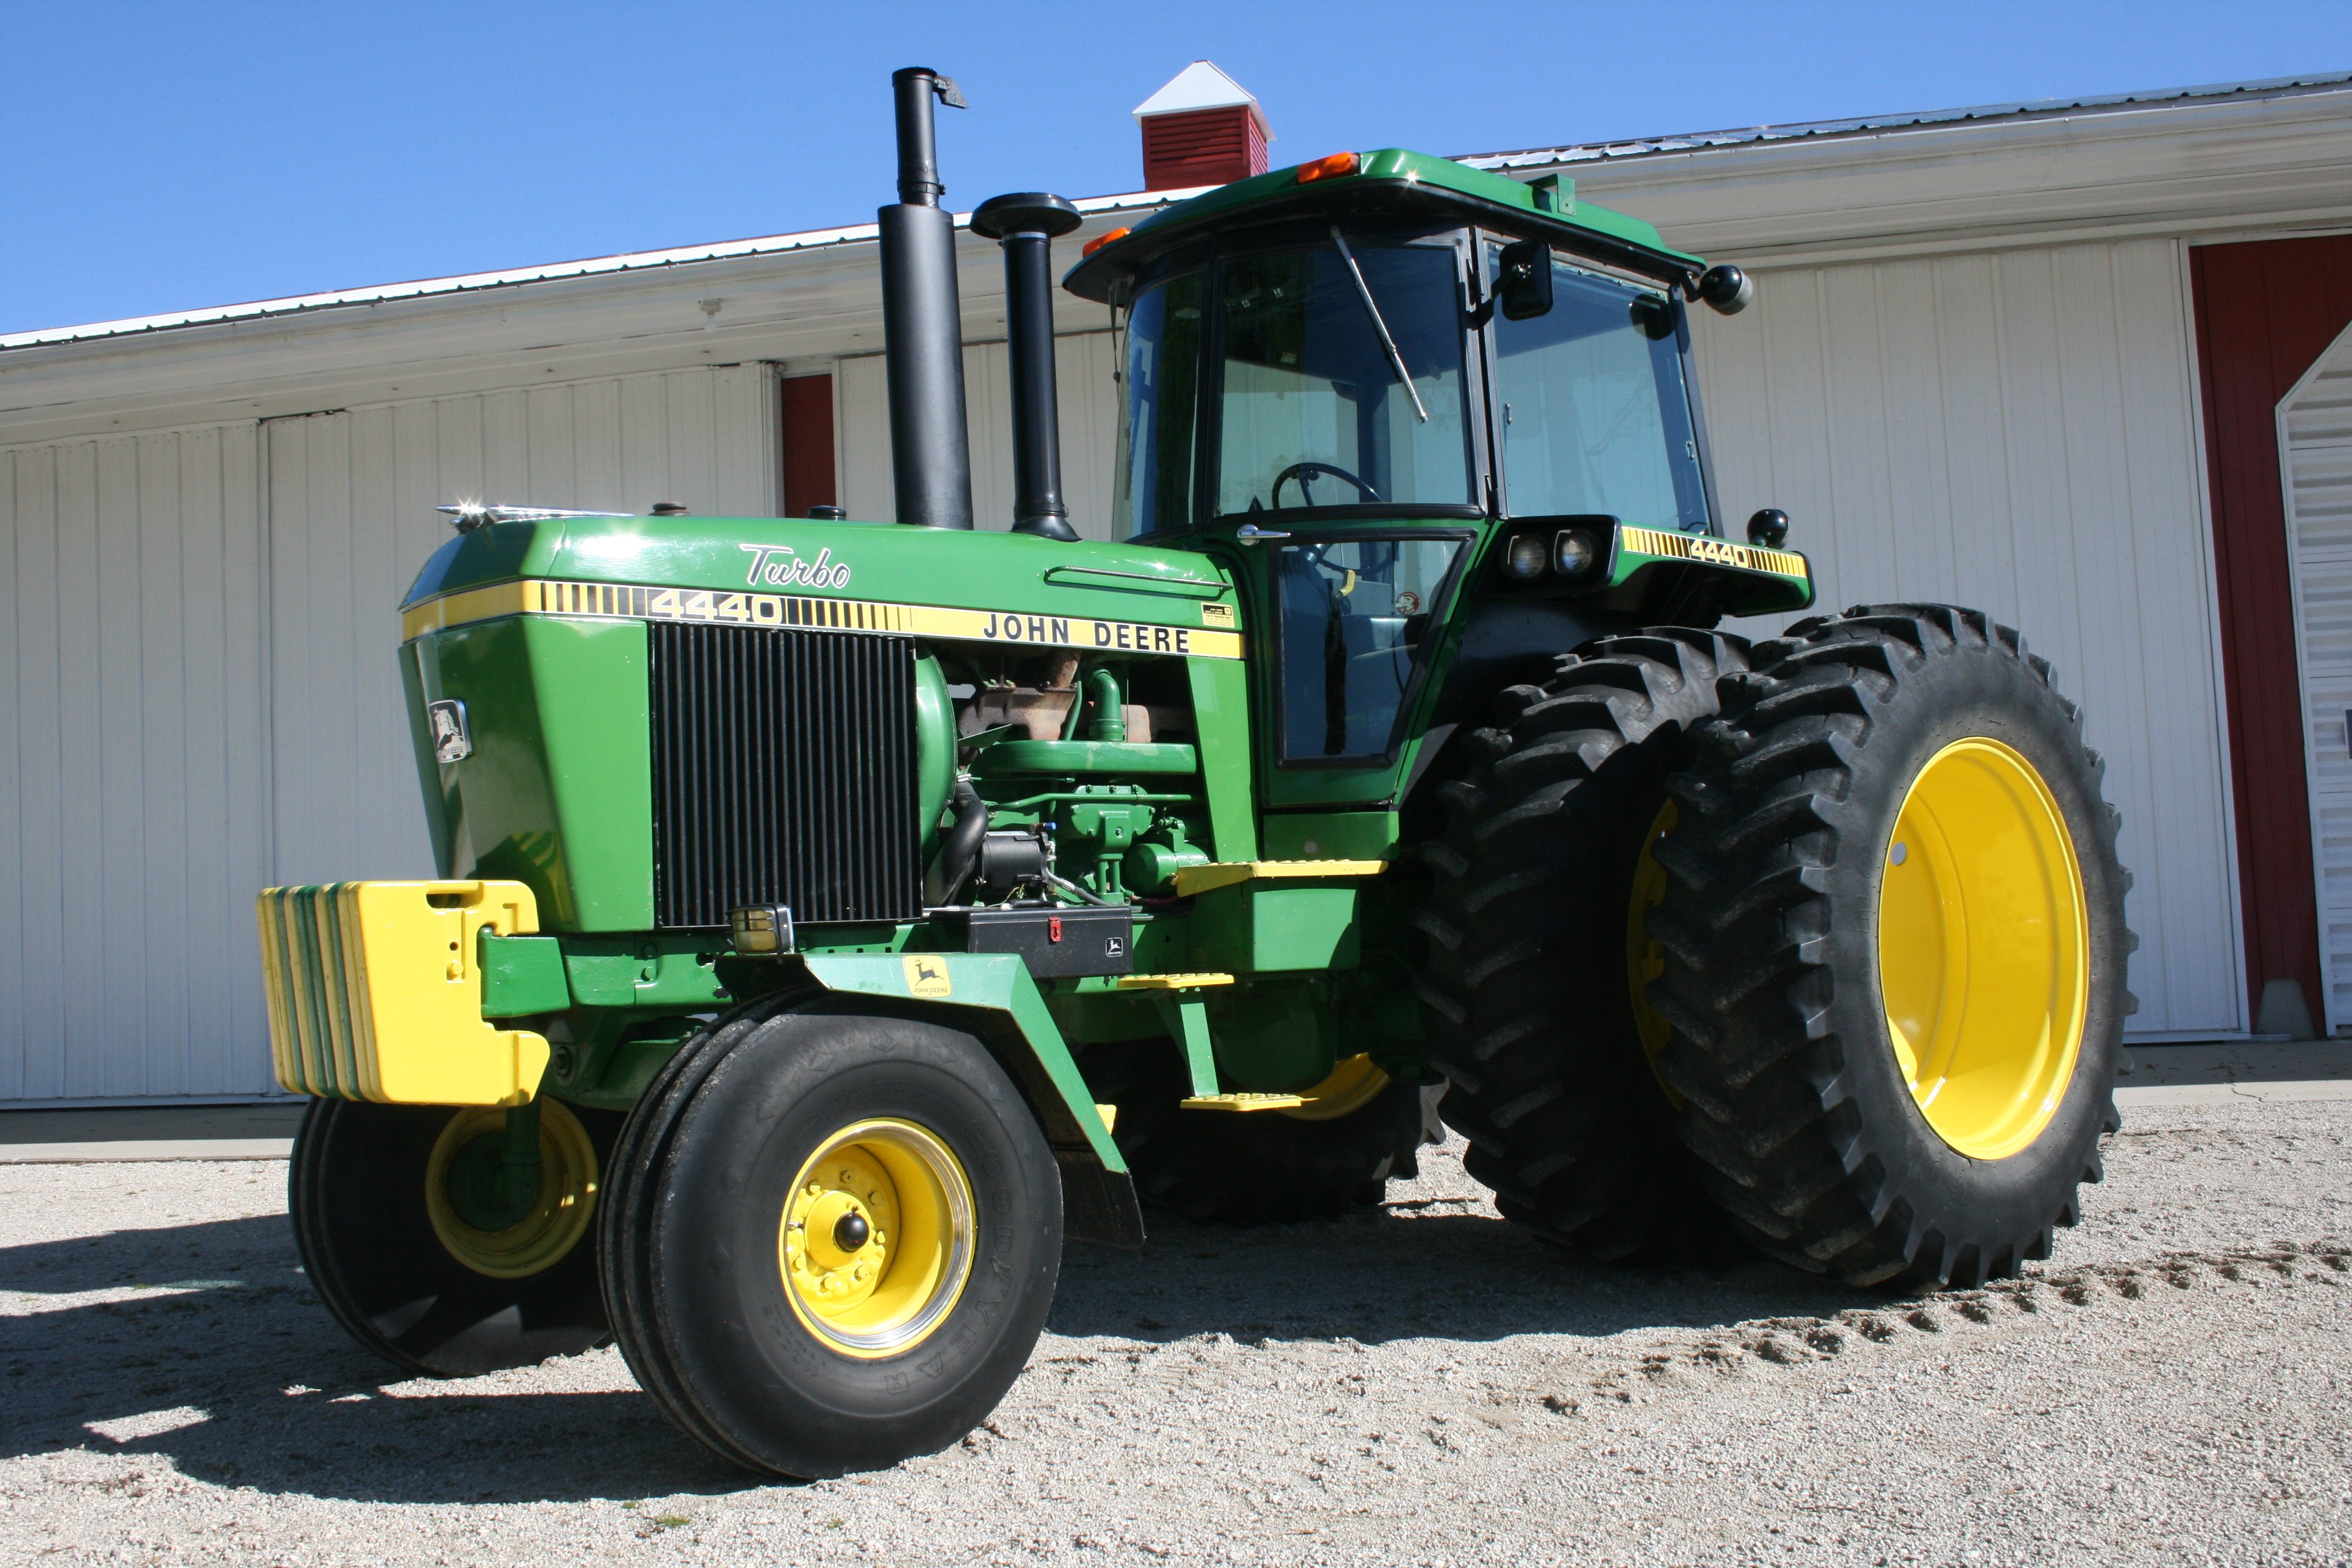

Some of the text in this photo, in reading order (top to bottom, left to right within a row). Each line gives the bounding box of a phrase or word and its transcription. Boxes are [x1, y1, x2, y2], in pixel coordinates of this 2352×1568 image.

[739, 543, 851, 589] Turbo
[1690, 538, 1749, 568] 4440
[652, 589, 783, 624] 4440
[983, 613, 1189, 653] JOHN DEERE
